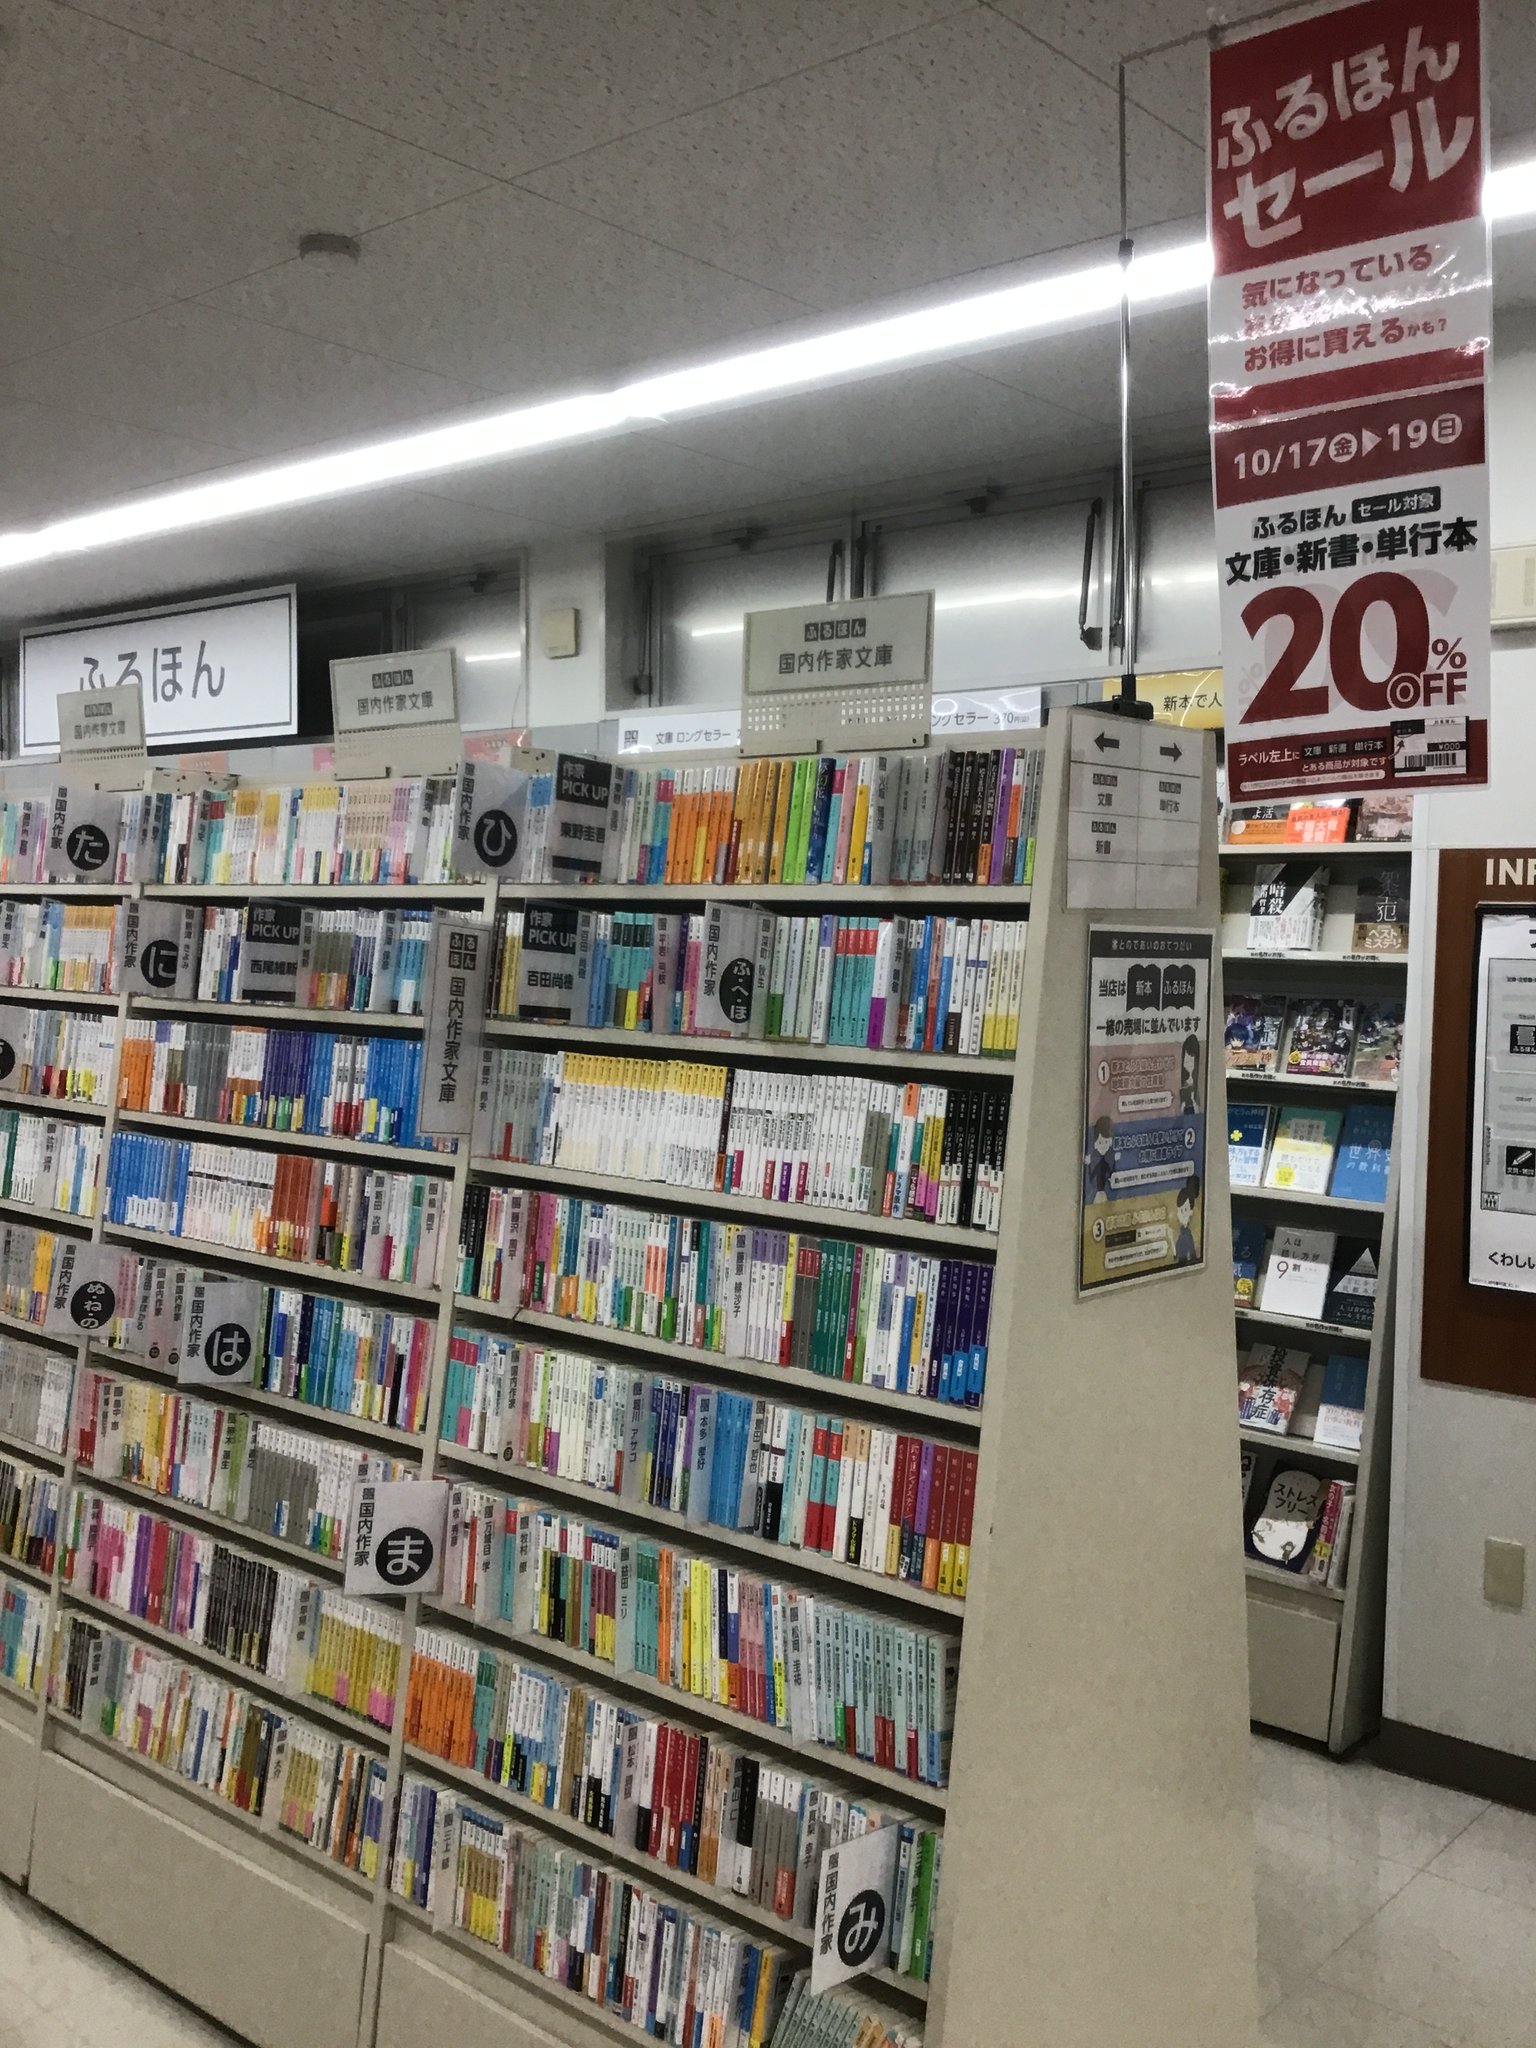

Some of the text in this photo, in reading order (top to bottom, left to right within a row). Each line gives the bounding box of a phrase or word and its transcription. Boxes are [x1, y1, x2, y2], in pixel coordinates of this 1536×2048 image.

[1217, 26, 1460, 169] ふるほん
[1223, 97, 1474, 248] セール
[1242, 244, 1432, 310] 気になっている
[1357, 491, 1435, 519] セール対象
[1253, 504, 1346, 539] ふるほん
[1225, 516, 1478, 586] 文庫・新書・単行本
[804, 617, 867, 643] ふるほん
[778, 643, 894, 675] 国内作家文庫
[356, 688, 434, 716] 国内作家文庫
[1387, 671, 1467, 709] OFF
[73, 720, 127, 741] 国内作家文庫
[655, 729, 674, 745] 文庫
[676, 727, 732, 744] ロングセラー
[562, 760, 585, 781] 作家
[1238, 748, 1300, 767] ラベル左上に
[1303, 744, 1322, 757] 文庫
[1302, 756, 1387, 773] とある商品が対象です
[561, 781, 609, 802] PICK UP
[1097, 792, 1113, 808] 文庫
[51, 799, 67, 850] 国内作家
[457, 778, 475, 841] 国内作家
[483, 817, 513, 856] ひ
[1294, 820, 1338, 832] 本屋大賞
[72, 830, 104, 865] た
[1096, 839, 1112, 855] 新書
[1267, 883, 1287, 914] 暗殺
[253, 907, 276, 924] 作家
[529, 909, 554, 929] 作家
[123, 917, 141, 968] 国内作家
[252, 922, 300, 941] PICK UP
[529, 929, 577, 949] PICK UP
[150, 946, 178, 979] に
[703, 924, 721, 997] 国内作家
[526, 969, 574, 990] 百田尚樹
[1098, 978, 1195, 998] 当店は 新本 ふるほん
[437, 976, 467, 1104] 国内作家文庫
[1096, 1016, 1201, 1037] 一緒の売場に並んでいます
[1283, 1237, 1302, 1247] 人は
[53, 1255, 77, 1310] 国内作家
[186, 1296, 206, 1358] 国内作家
[211, 1330, 245, 1368] は
[1273, 1482, 1319, 1507] ストレス
[1275, 1496, 1309, 1515] フリー
[353, 1502, 376, 1567] 国内作家
[385, 1535, 425, 1577] ま
[820, 1872, 839, 1956] 国内作家
[844, 1902, 879, 1954] み
